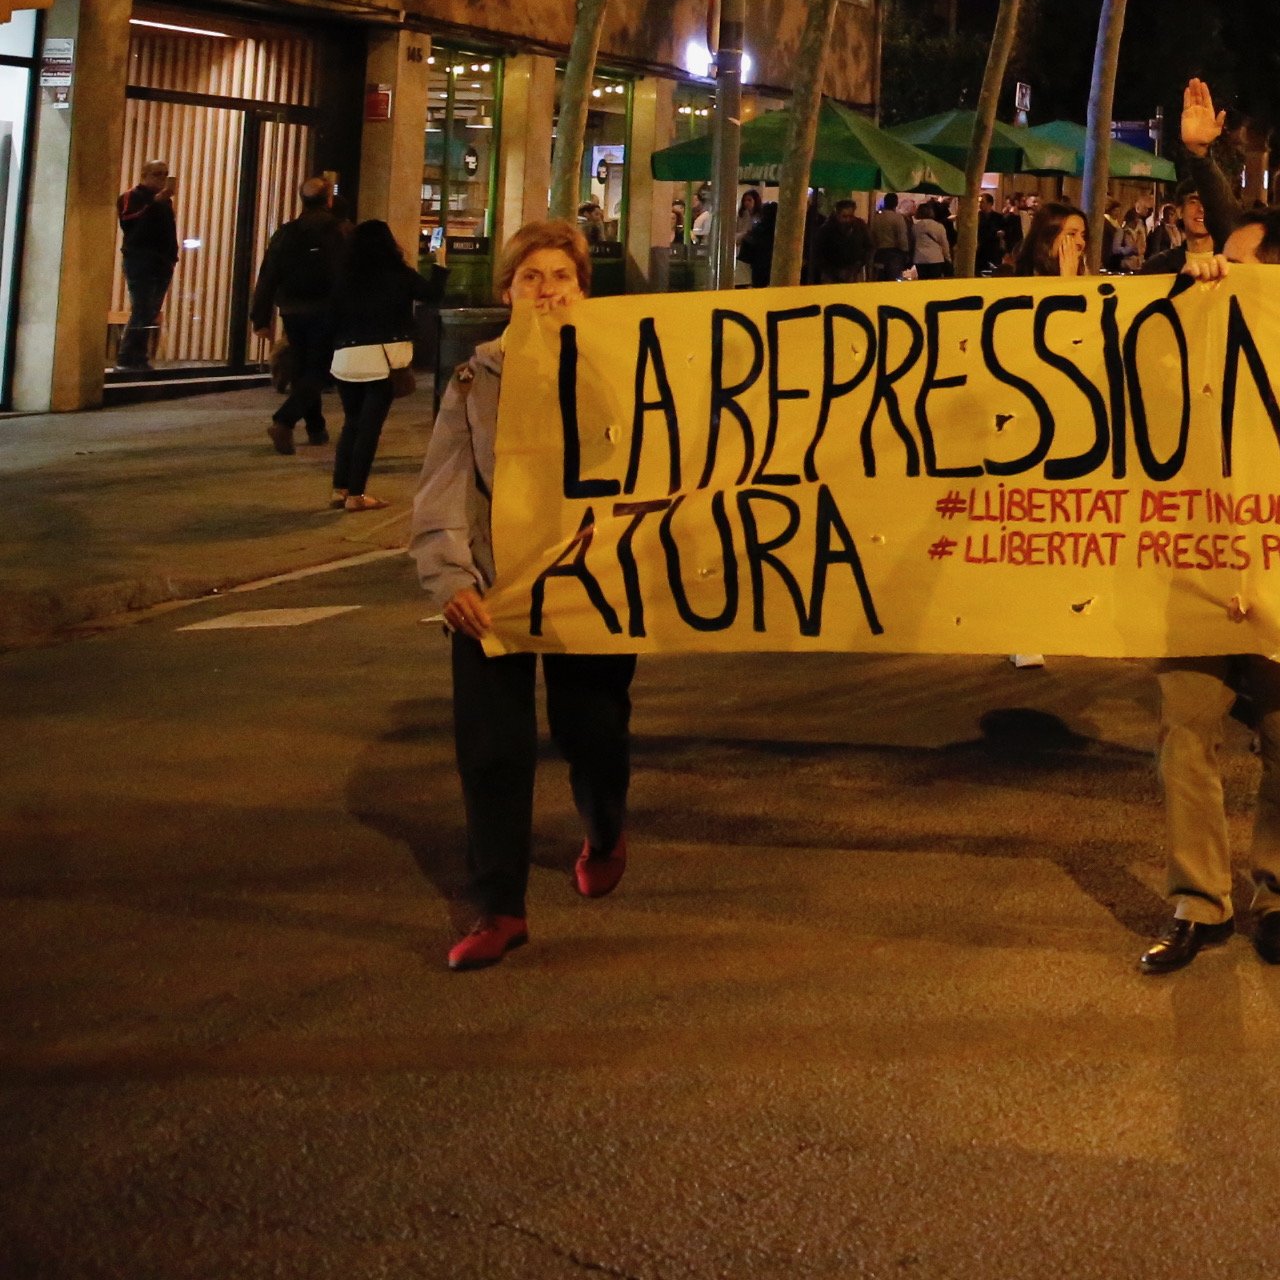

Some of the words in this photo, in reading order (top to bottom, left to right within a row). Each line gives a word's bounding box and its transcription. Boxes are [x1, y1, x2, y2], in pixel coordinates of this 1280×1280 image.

[559, 317, 680, 499] LA
[529, 484, 884, 637] ATURA
[1138, 531, 1250, 570] PRESES
